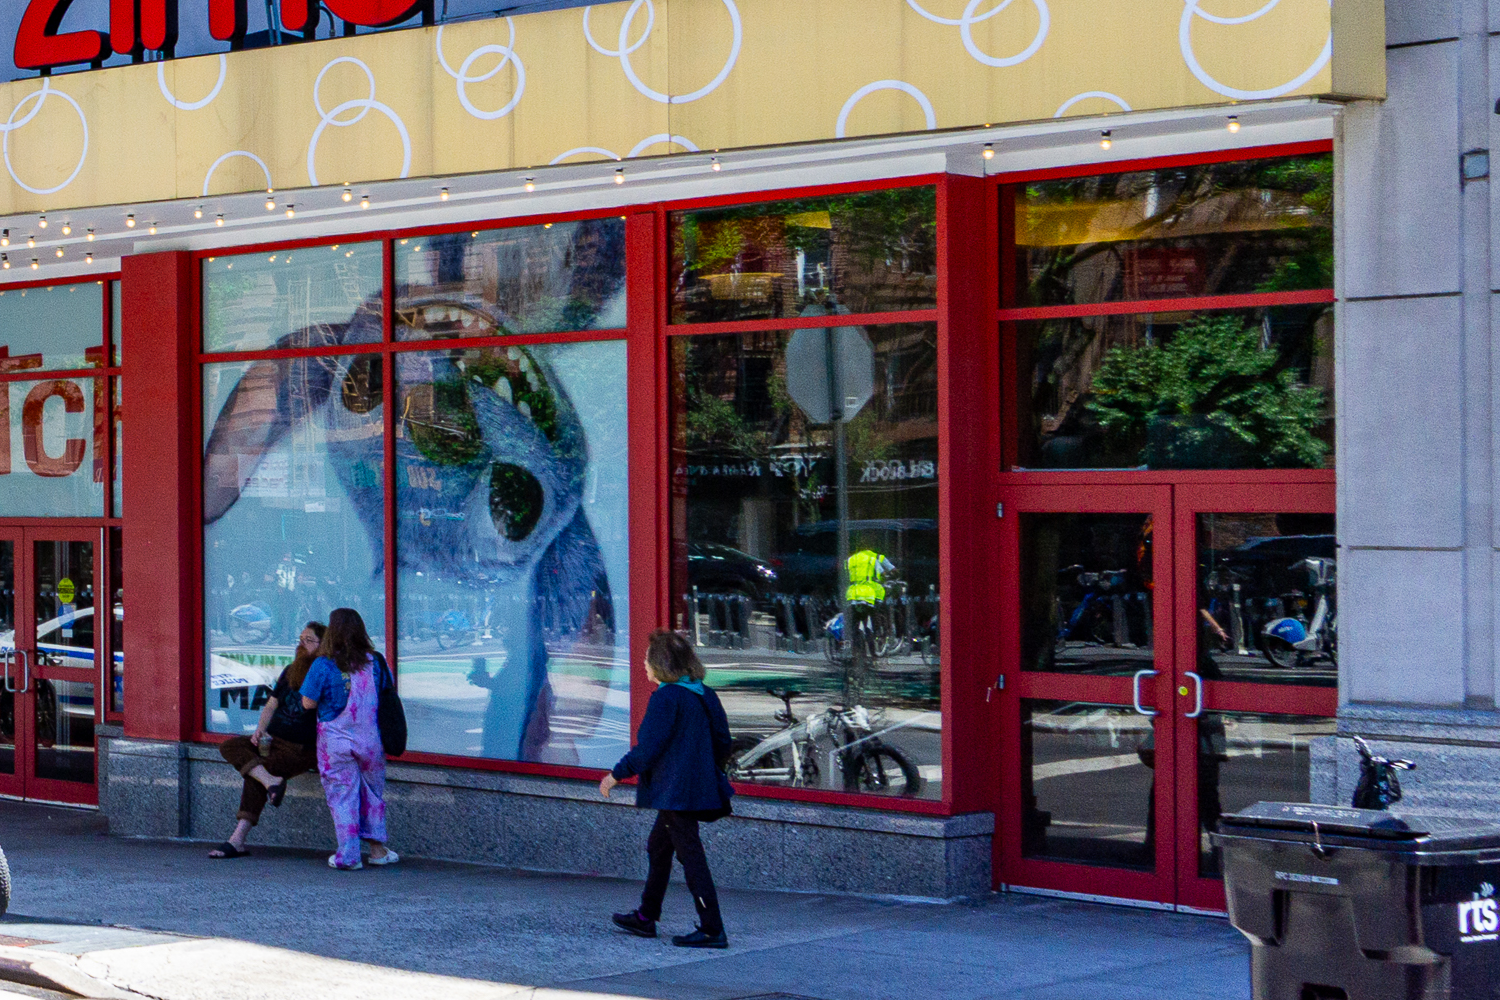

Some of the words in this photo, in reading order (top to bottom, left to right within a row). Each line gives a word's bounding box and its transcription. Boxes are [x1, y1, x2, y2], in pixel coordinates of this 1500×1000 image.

[260, 655, 276, 667] IN
[220, 685, 269, 710] MA
[1458, 892, 1499, 934] rts
